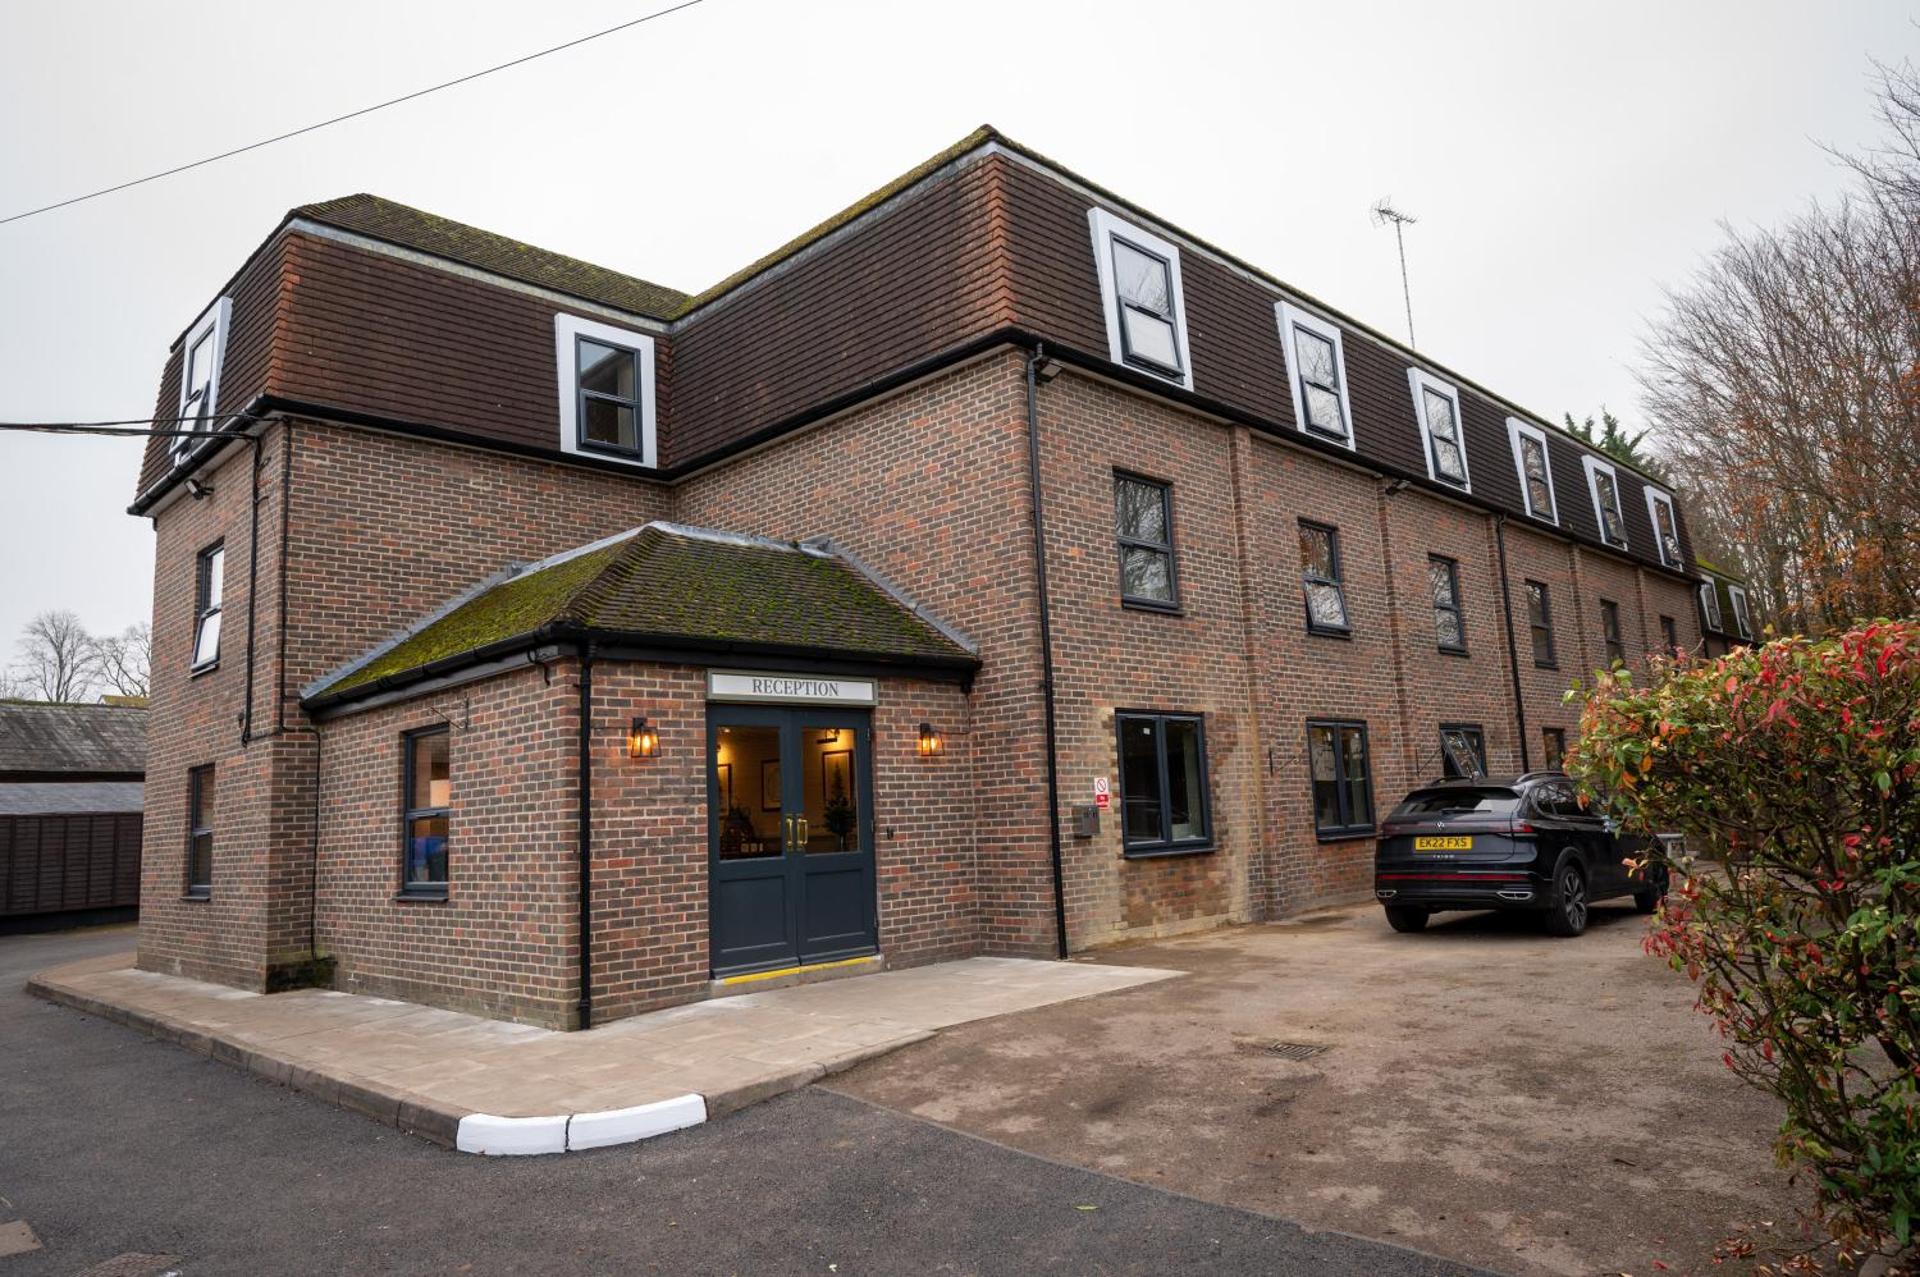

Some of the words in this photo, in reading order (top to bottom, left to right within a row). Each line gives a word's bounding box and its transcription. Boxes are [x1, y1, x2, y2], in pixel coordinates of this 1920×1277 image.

[752, 678, 839, 696] RECEPTION
[1419, 838, 1444, 848] EK22
[1447, 838, 1467, 848] FXS
